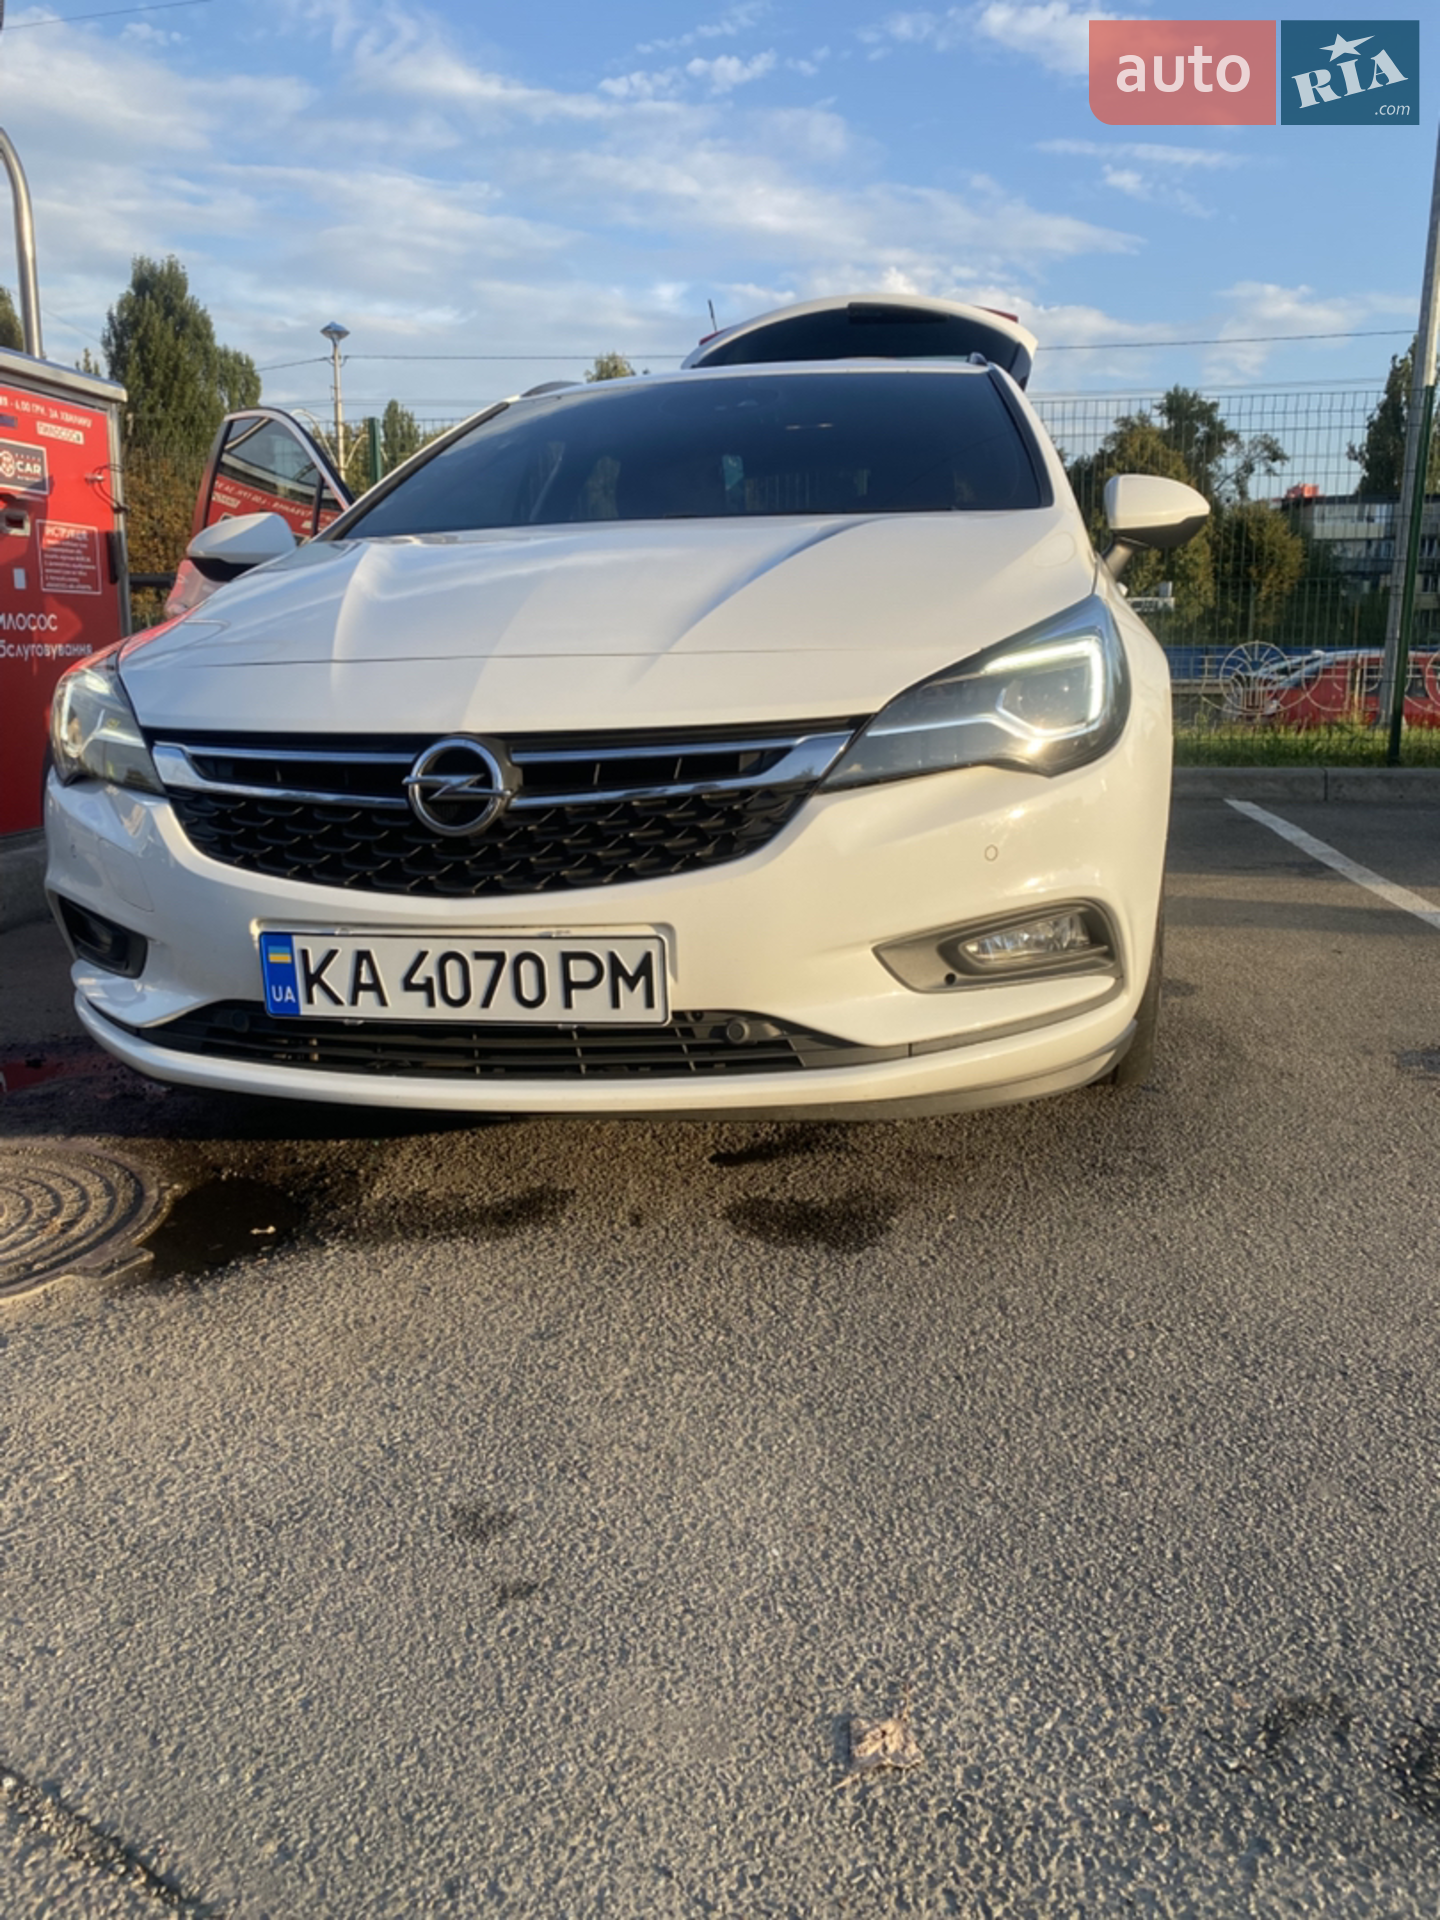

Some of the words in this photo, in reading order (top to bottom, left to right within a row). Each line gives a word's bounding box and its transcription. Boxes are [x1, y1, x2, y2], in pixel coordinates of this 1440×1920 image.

[16, 460, 42, 475] CAR
[301, 948, 389, 1007] KA
[403, 950, 547, 1009] 4070
[560, 950, 657, 1010] PM
[271, 985, 296, 1003] UA
